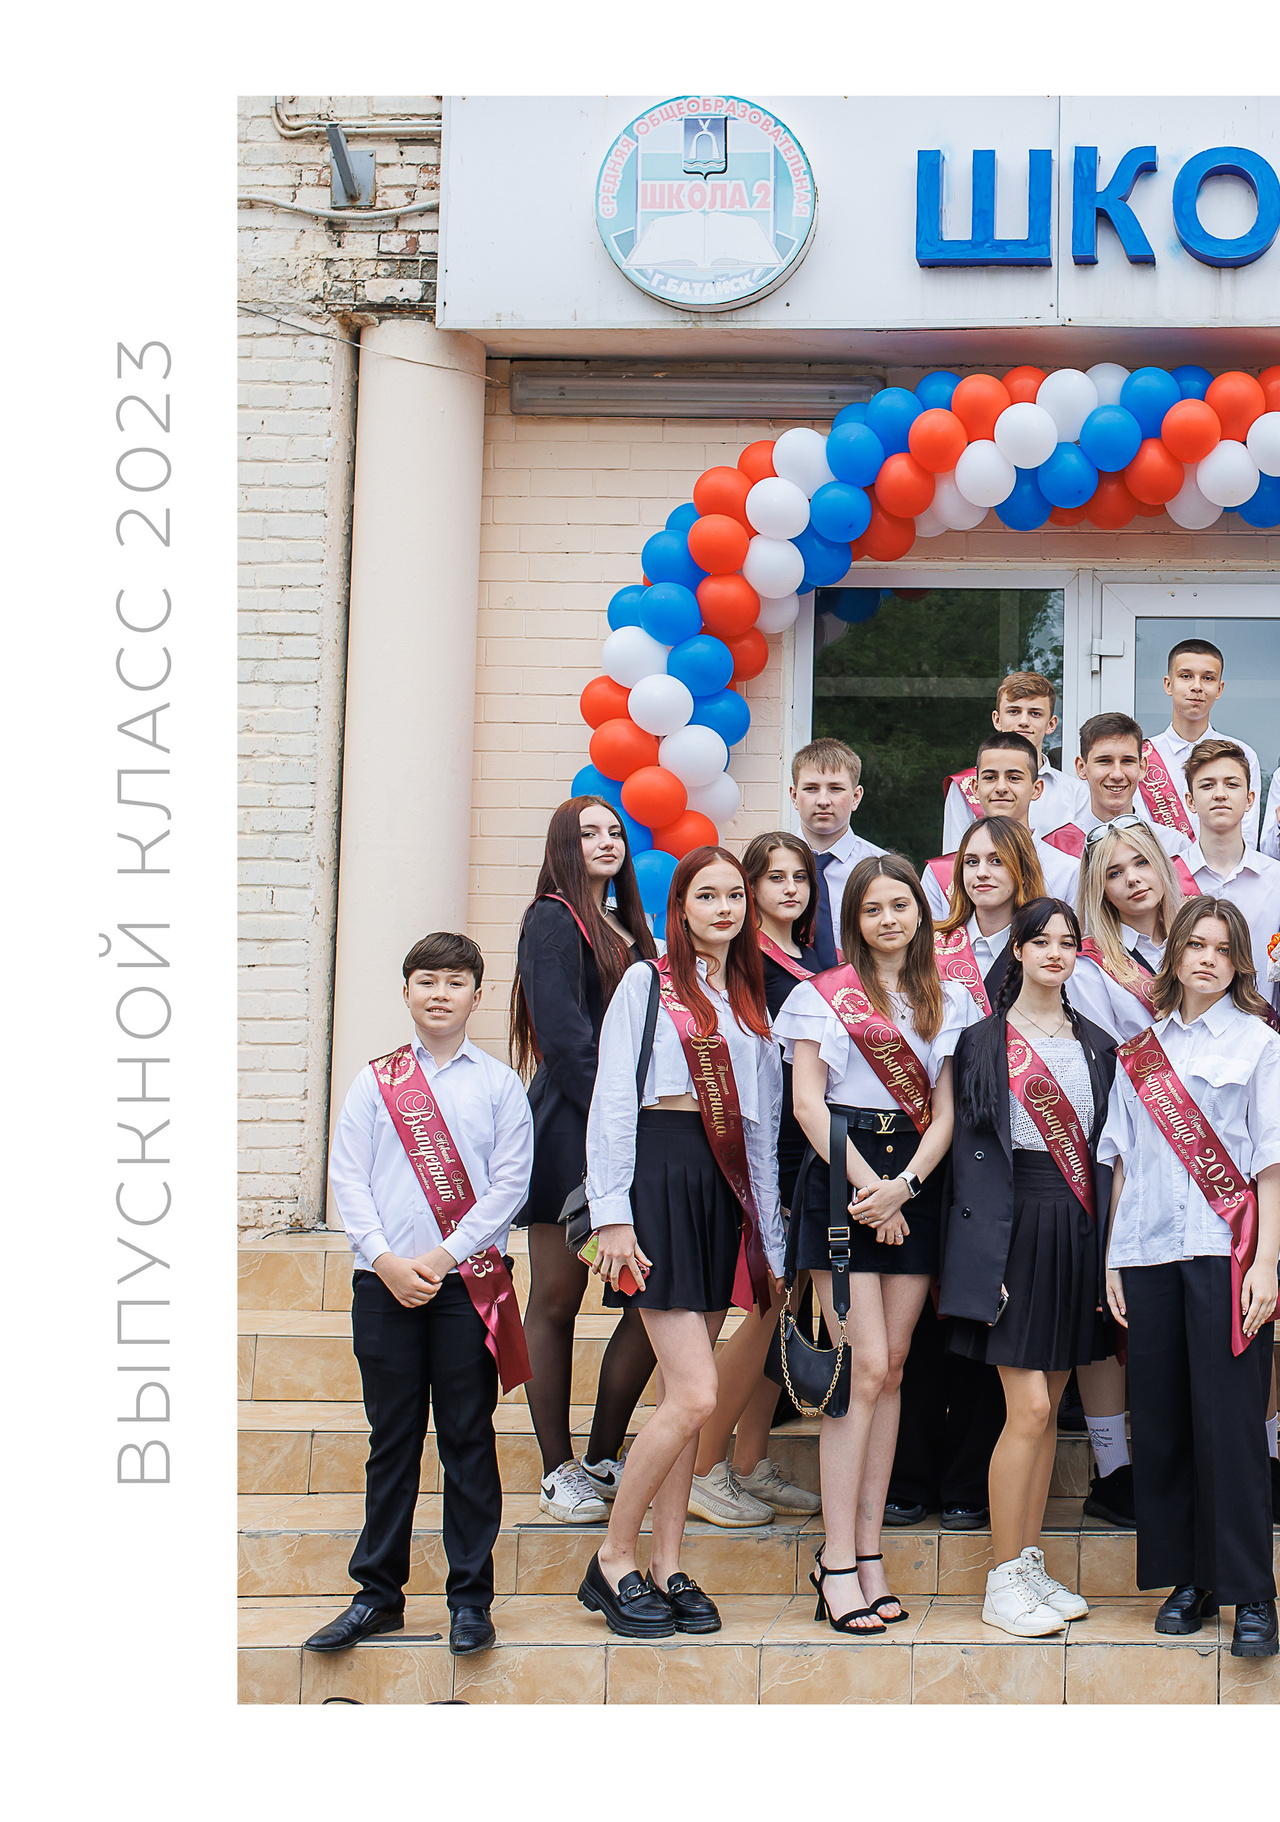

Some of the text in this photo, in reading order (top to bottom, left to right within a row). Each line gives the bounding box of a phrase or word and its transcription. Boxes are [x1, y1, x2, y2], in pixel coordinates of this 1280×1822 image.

[600, 98, 810, 217] СРЕДНЯЯ ОБЩЕОБРАЗОВАТЕЛЬНАЯ
[641, 183, 771, 210] ШКОЛА 2
[684, 1017, 725, 1138] Выпускница
[1134, 1050, 1195, 1144] Выпускница
[395, 1089, 456, 1203] Выпускник
[1194, 1148, 1244, 1207] 2023
